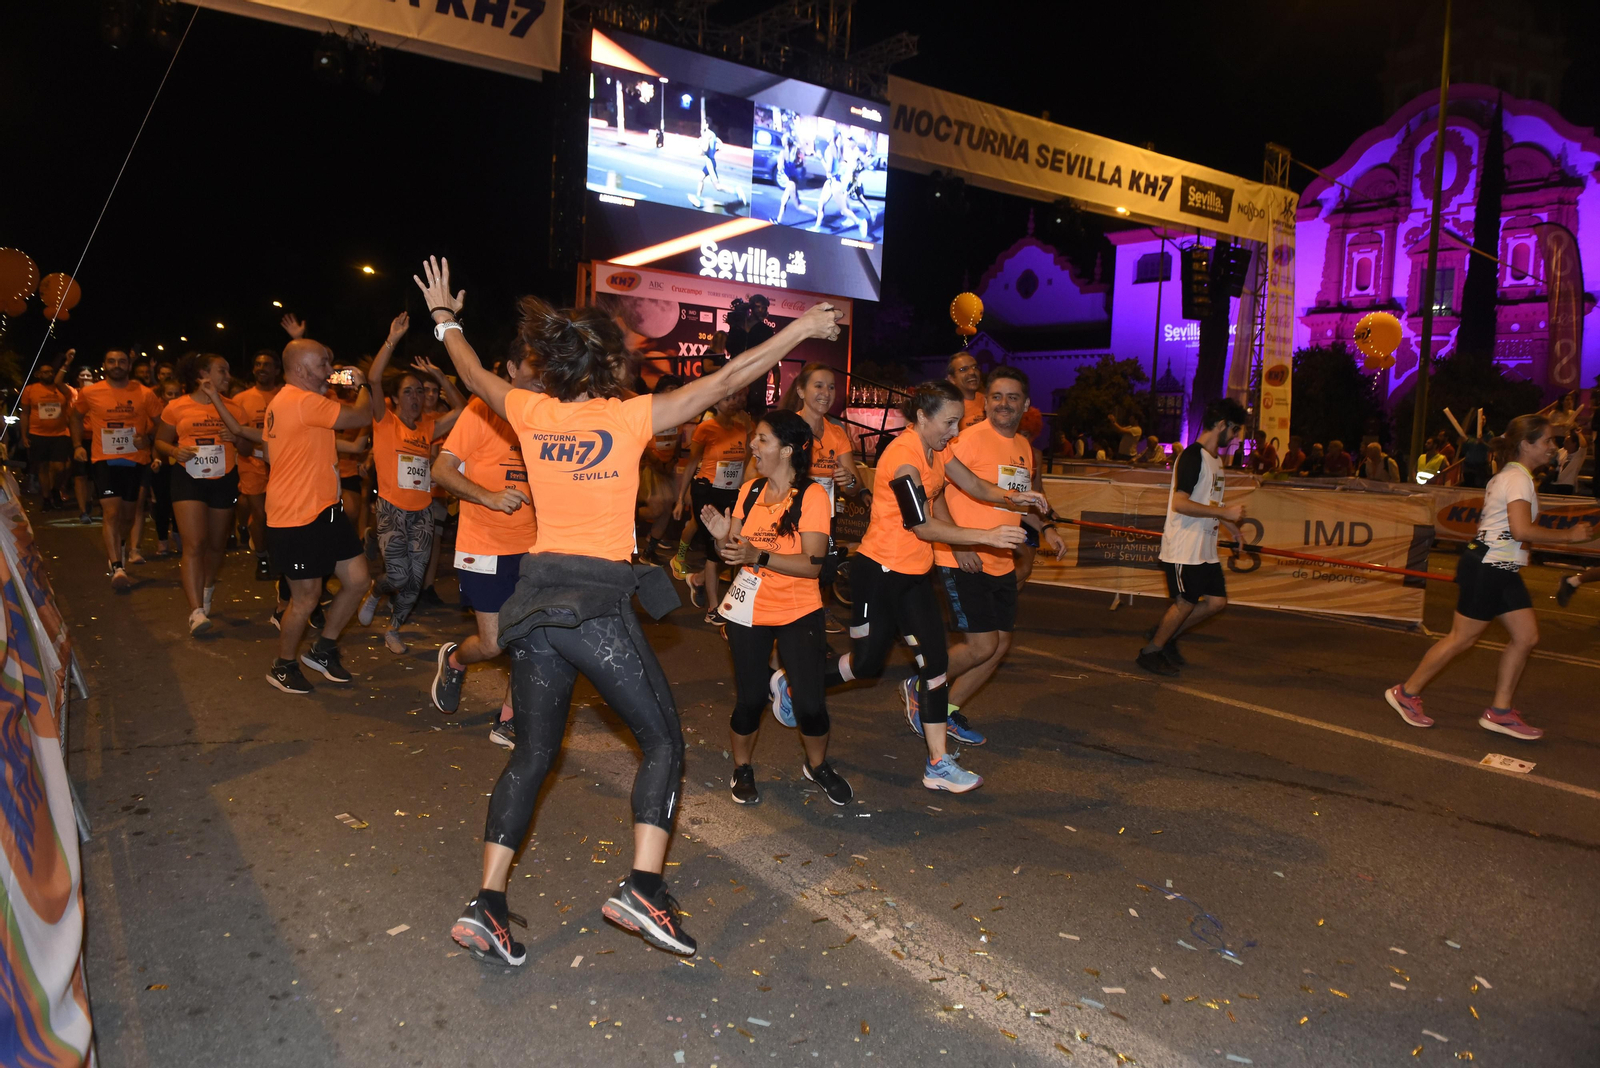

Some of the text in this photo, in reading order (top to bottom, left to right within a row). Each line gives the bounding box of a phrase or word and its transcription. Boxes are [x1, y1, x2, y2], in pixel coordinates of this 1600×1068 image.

[893, 103, 1029, 164] NOCTURNA
[1035, 143, 1122, 188] SEVILLA
[649, 280, 664, 290] ABC
[671, 284, 703, 296] Cruzcampo
[532, 433, 577, 442] NOCTURNA
[194, 456, 219, 465] 20160
[572, 470, 619, 481] SEVILLA
[1304, 519, 1373, 547] IMD
[1104, 551, 1154, 562] DE SEVILLA
[1292, 568, 1368, 584] de Deportes
